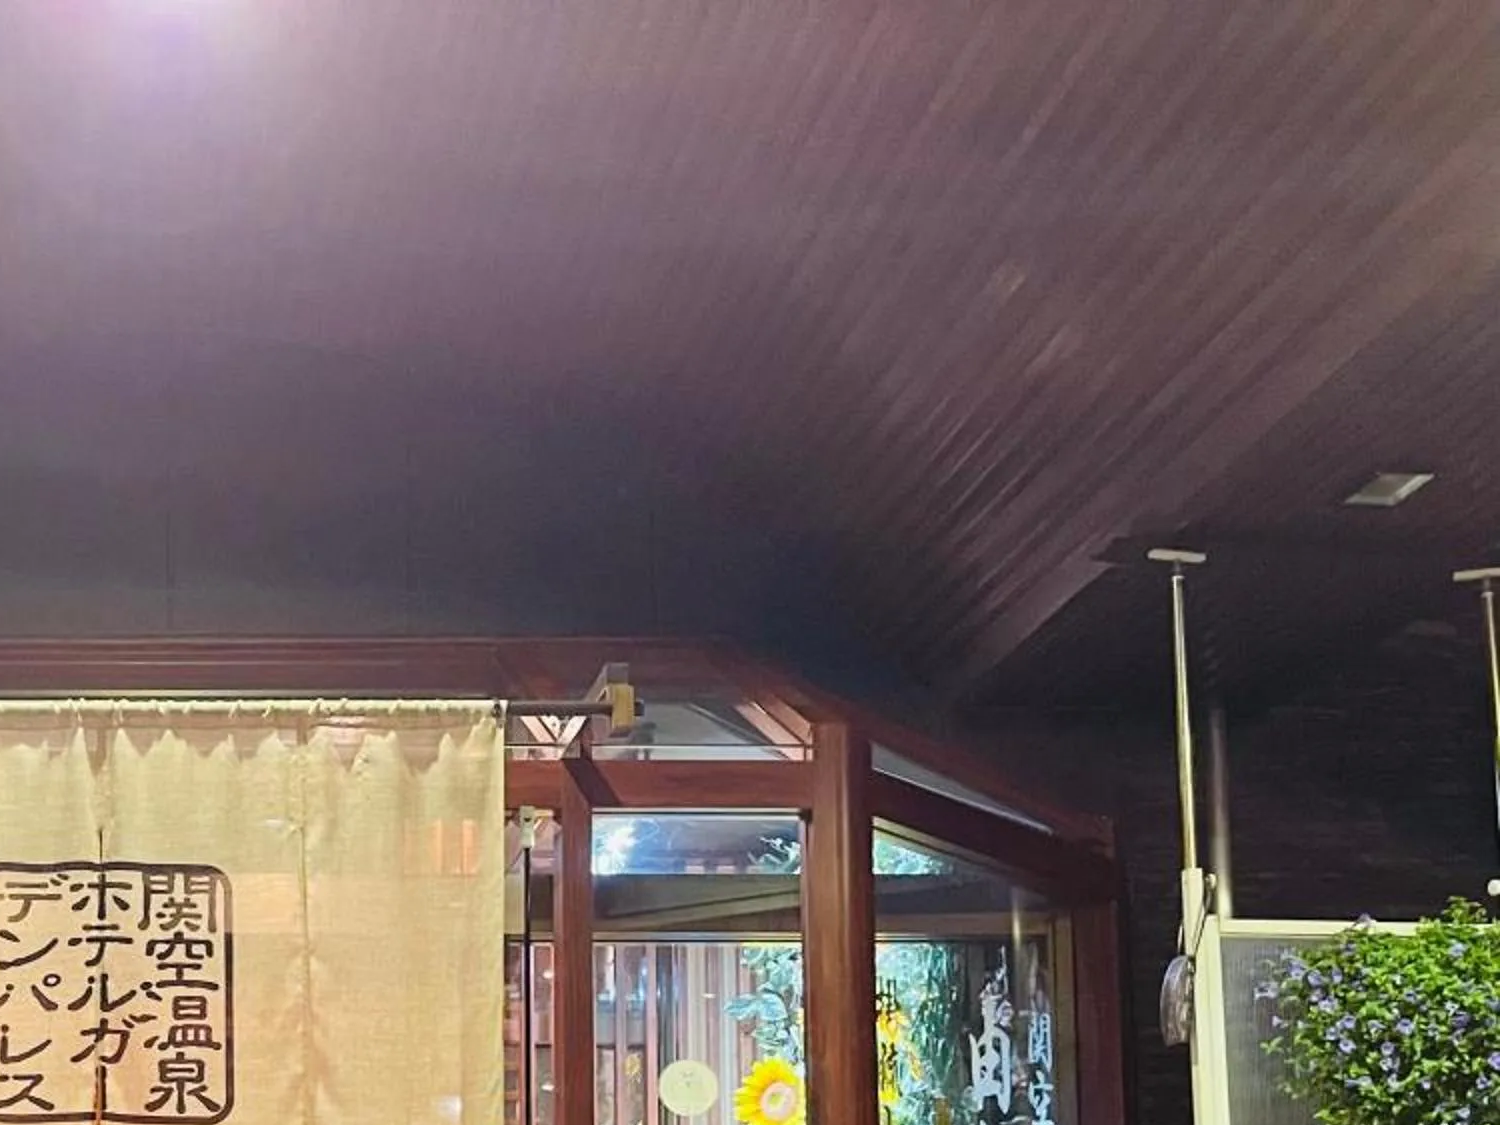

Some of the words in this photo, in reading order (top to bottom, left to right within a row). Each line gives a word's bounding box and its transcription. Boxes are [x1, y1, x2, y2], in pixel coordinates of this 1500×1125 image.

[67, 873, 158, 1111] ホテルガー
[138, 871, 222, 1114] 関空温泉
